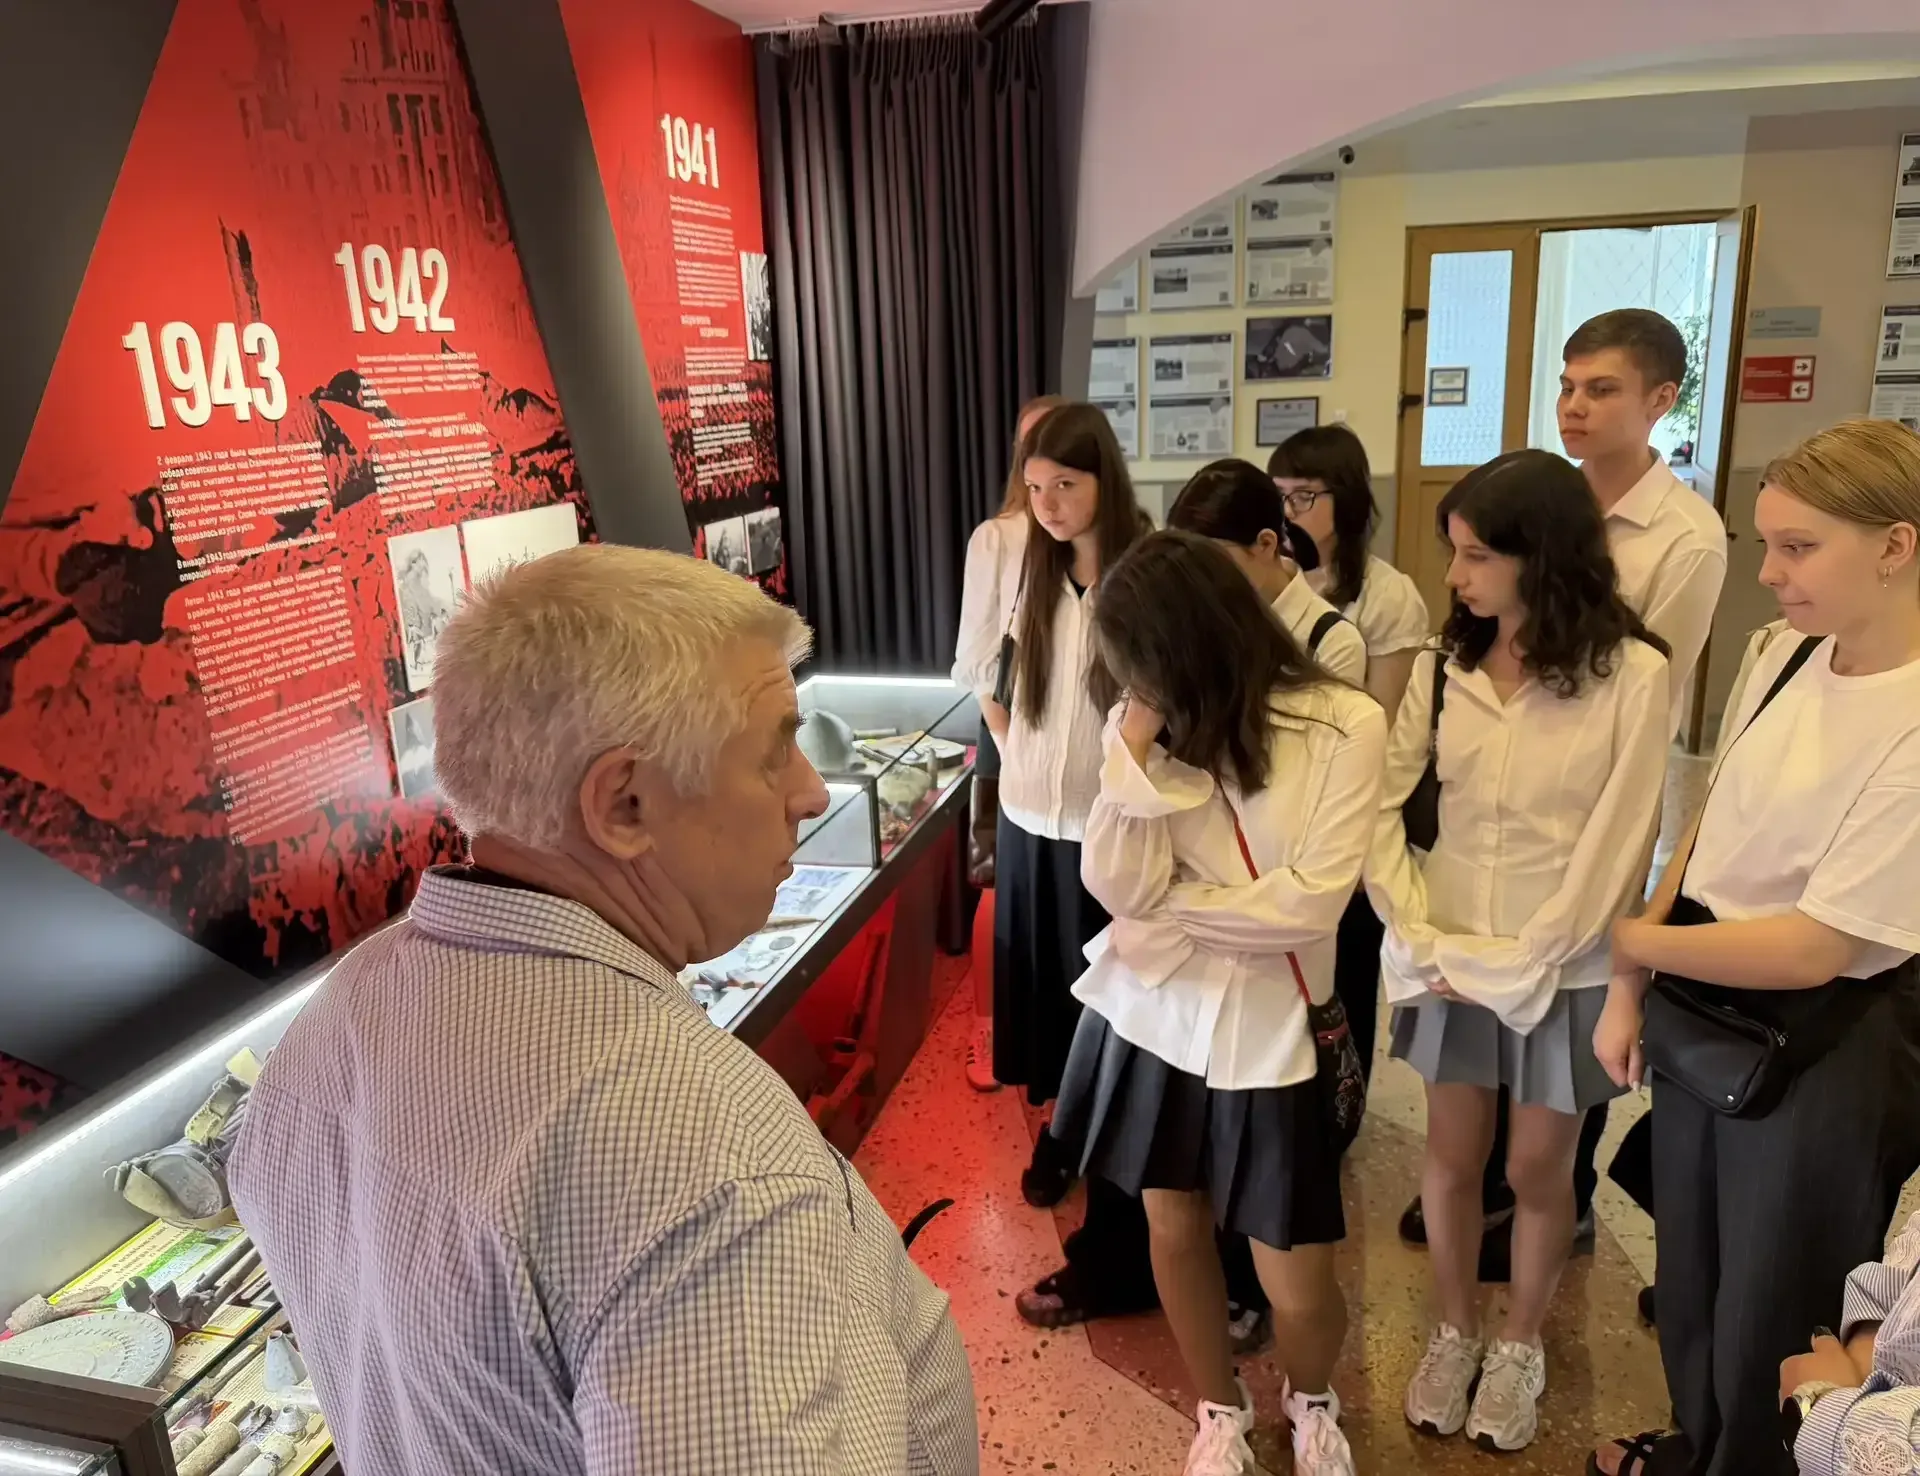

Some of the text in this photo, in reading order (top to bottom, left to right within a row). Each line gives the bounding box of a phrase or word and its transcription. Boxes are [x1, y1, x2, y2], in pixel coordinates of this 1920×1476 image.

[660, 112, 719, 189] 1941
[334, 242, 456, 334] 1942
[121, 321, 288, 429] 1943
[442, 426, 460, 438] ШАГУ
[164, 454, 193, 466] февраля
[195, 451, 212, 461] 1943
[213, 451, 228, 460] года
[159, 469, 184, 479] победа
[184, 465, 217, 476] советских
[161, 483, 178, 492] ская
[180, 480, 200, 489] битва
[202, 475, 234, 486] считается
[164, 495, 185, 505] после
[187, 490, 216, 501] которого
[171, 504, 200, 518] Красной
[169, 521, 186, 530] лось
[187, 519, 196, 527] по
[198, 516, 218, 525] всему
[218, 513, 236, 523] миру.
[172, 529, 218, 544] передавалось
[182, 556, 205, 567] январе
[205, 551, 223, 563] 1943
[179, 569, 211, 581] операции
[207, 589, 224, 601] 1943
[225, 587, 240, 597] года
[191, 606, 215, 620] районе
[215, 598, 242, 613] Курской
[191, 632, 209, 643] было
[234, 683, 250, 695] 1943
